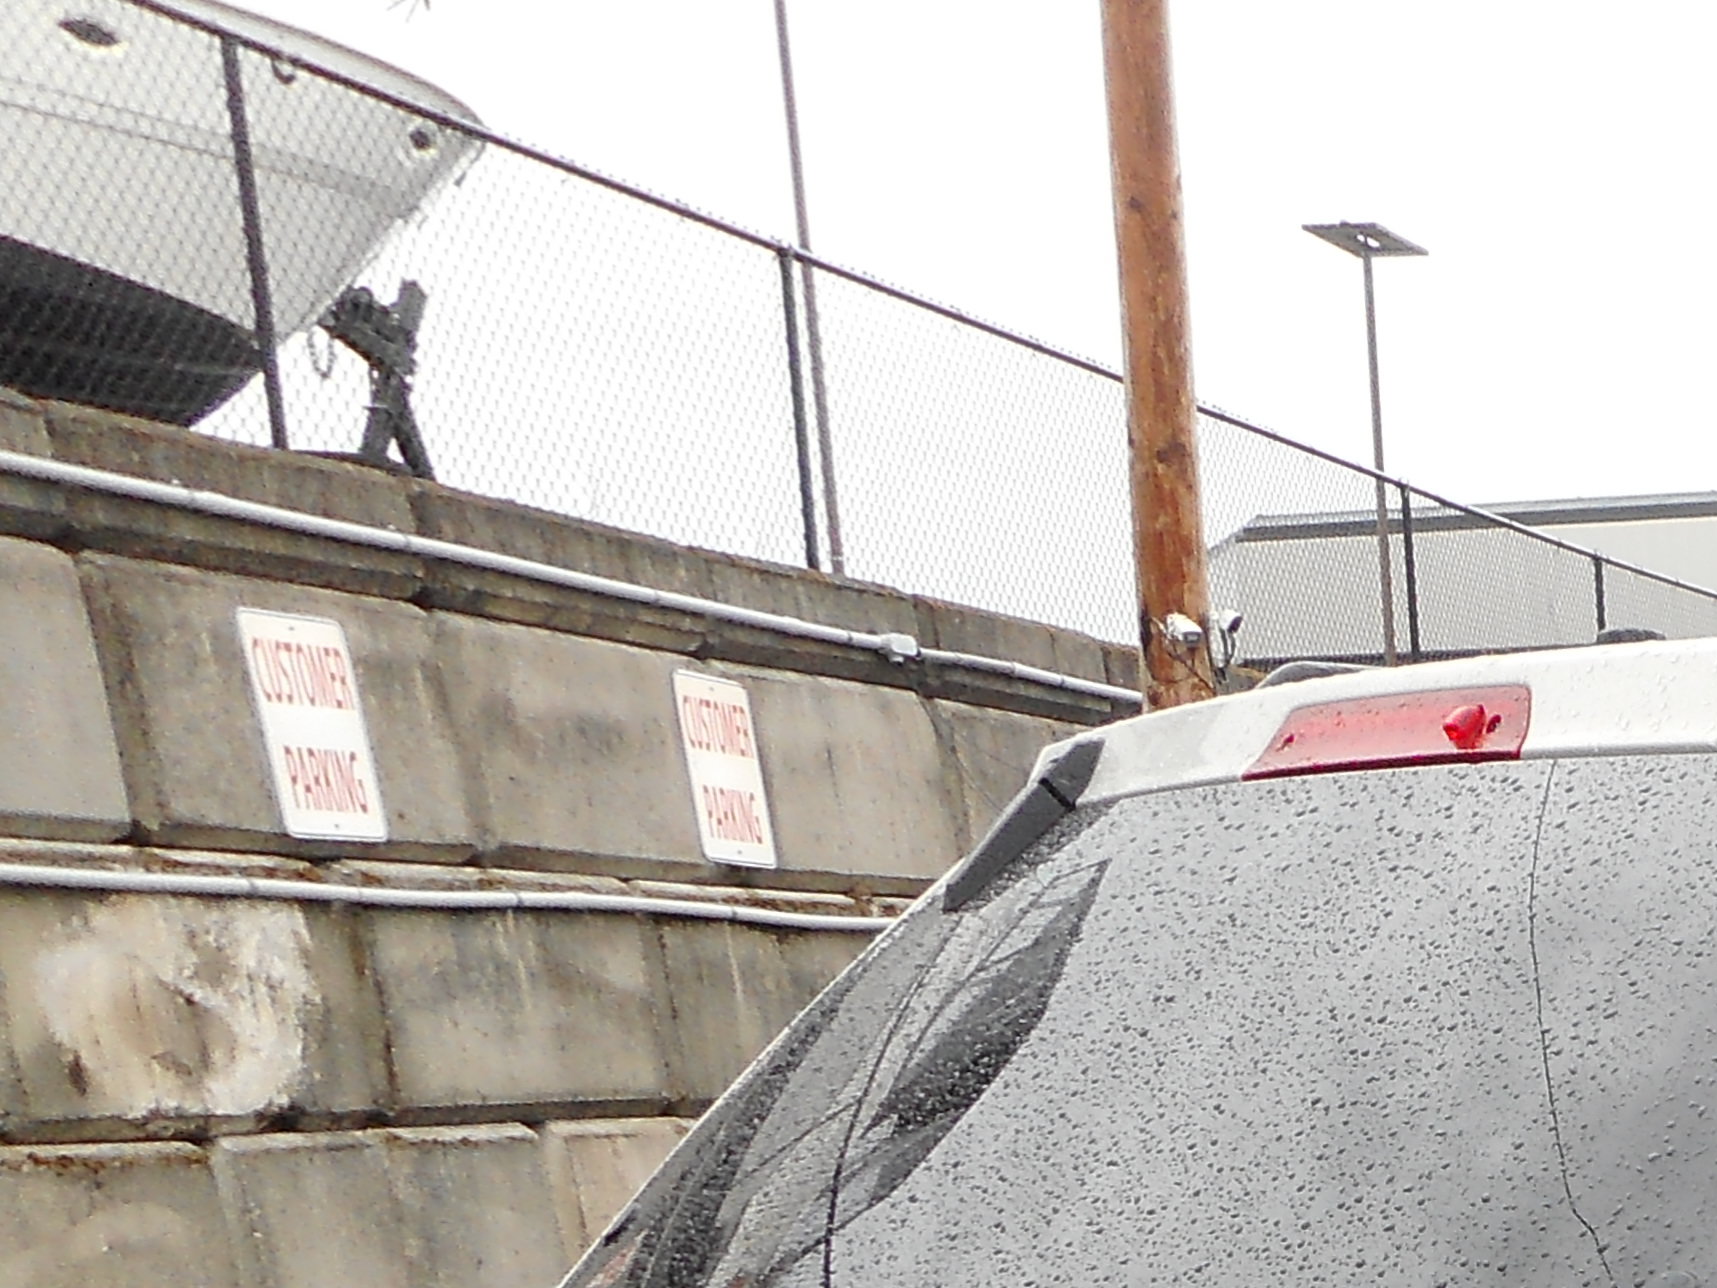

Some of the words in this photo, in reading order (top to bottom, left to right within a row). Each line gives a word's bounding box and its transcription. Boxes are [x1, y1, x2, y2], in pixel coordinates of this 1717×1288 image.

[251, 636, 356, 711] CUSTOMER
[682, 694, 756, 760] CUSTOMER
[282, 744, 369, 815] PARKING
[701, 784, 764, 845] PARKING
